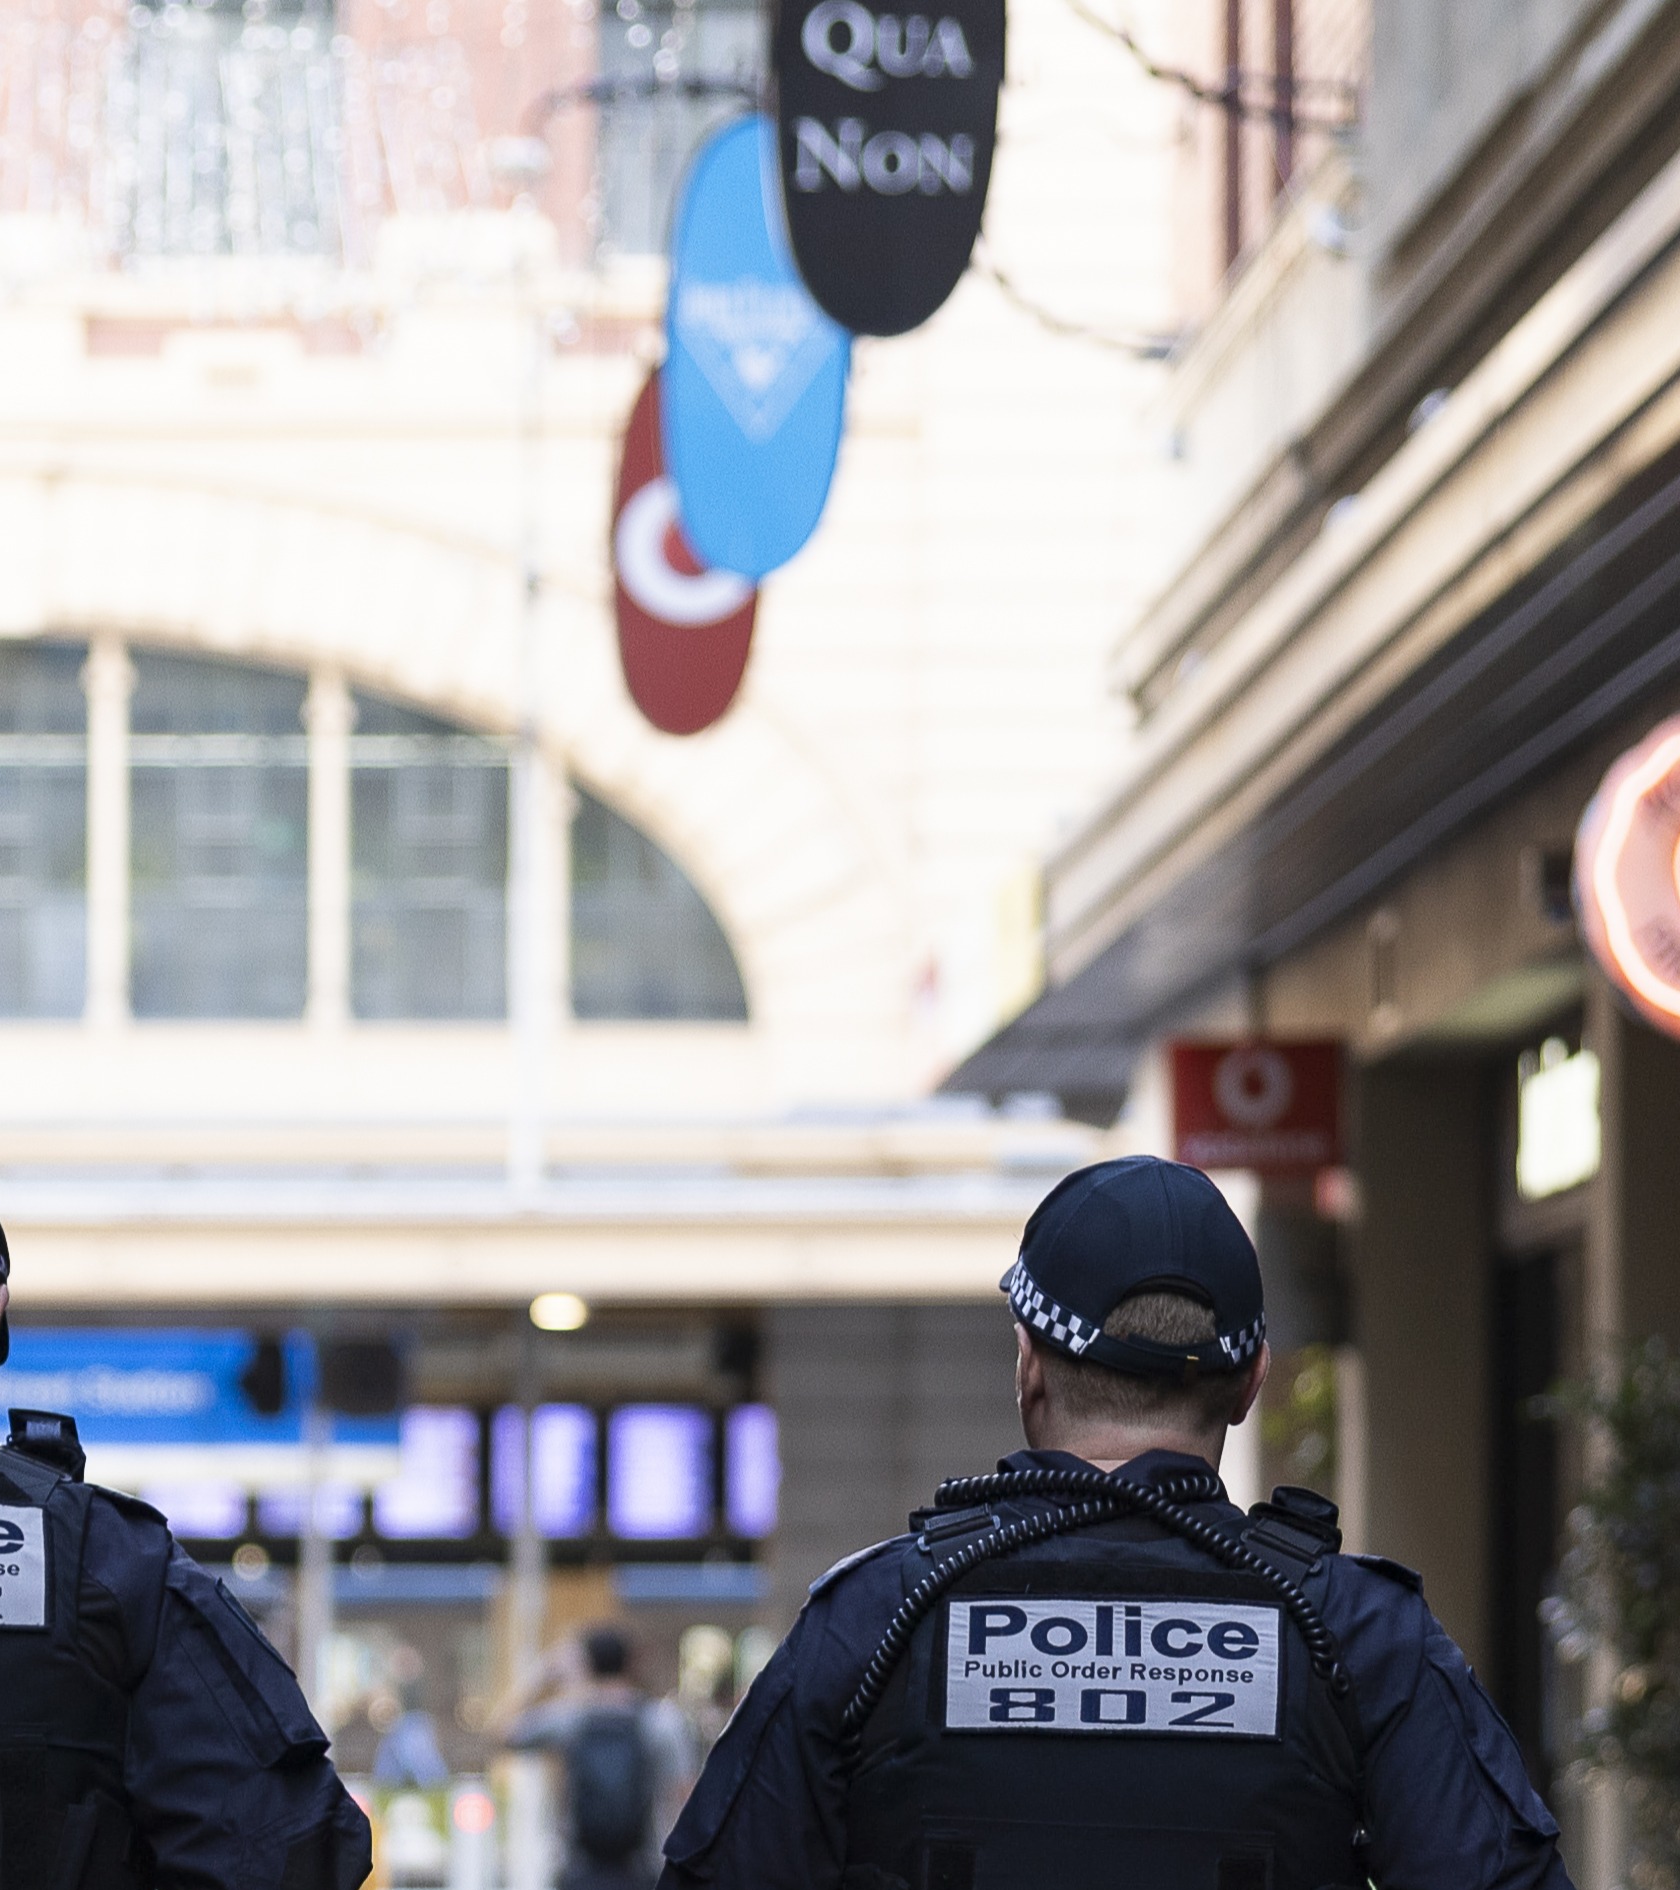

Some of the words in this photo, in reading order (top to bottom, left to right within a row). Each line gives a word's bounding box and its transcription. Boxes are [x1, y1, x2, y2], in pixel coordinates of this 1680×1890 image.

[801, 1, 973, 92] QUA
[796, 116, 973, 196] NON
[968, 1605, 1259, 1660] Police
[964, 1660, 1042, 1679] Public
[1051, 1661, 1121, 1680] Order
[1130, 1664, 1254, 1685] Response
[989, 1688, 1235, 1728] 802
